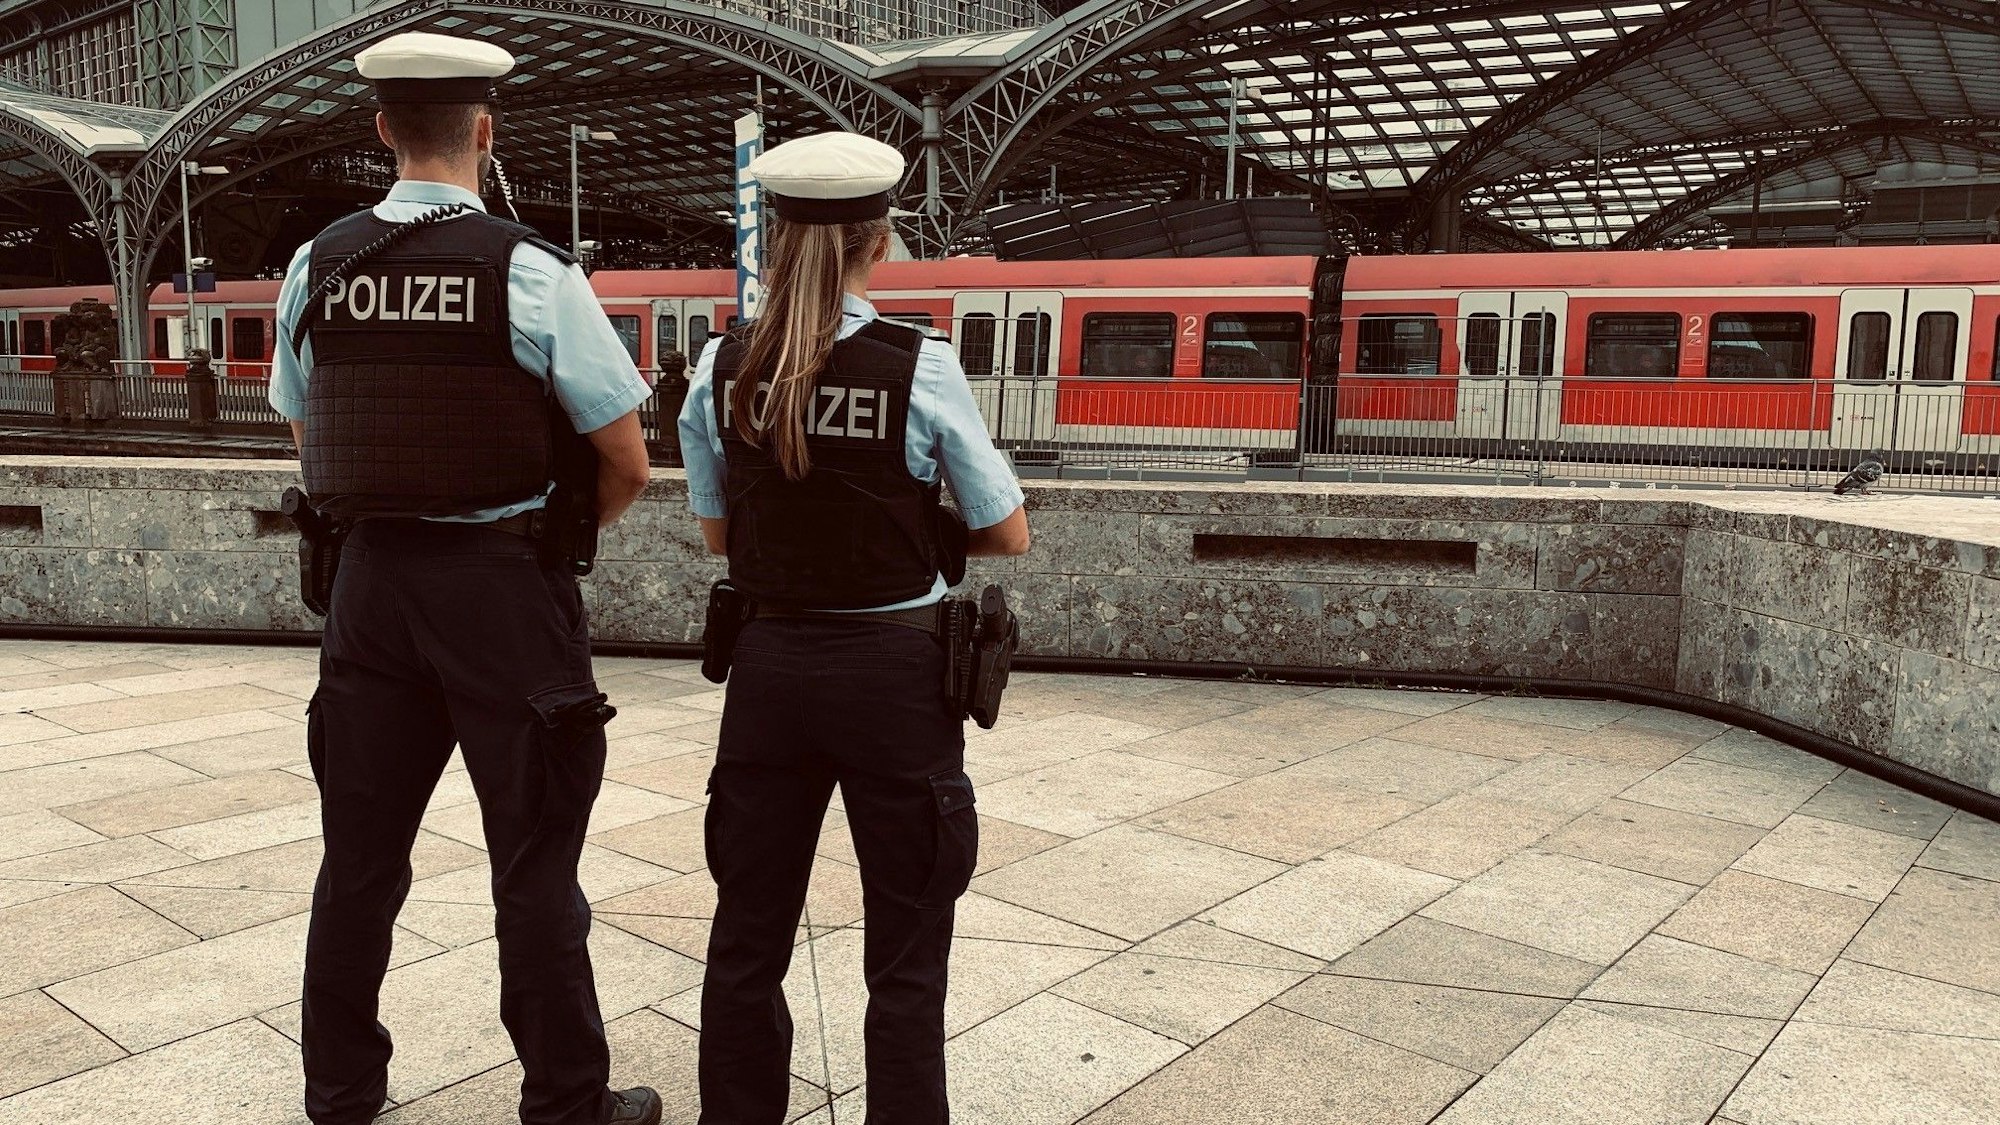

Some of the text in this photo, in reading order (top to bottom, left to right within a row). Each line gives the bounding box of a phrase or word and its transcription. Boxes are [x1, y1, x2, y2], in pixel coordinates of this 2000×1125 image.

[324, 275, 475, 322] POLIZEI
[1183, 315, 1198, 336] 2
[1687, 315, 1703, 336] 2
[723, 380, 888, 439] POIZEI
